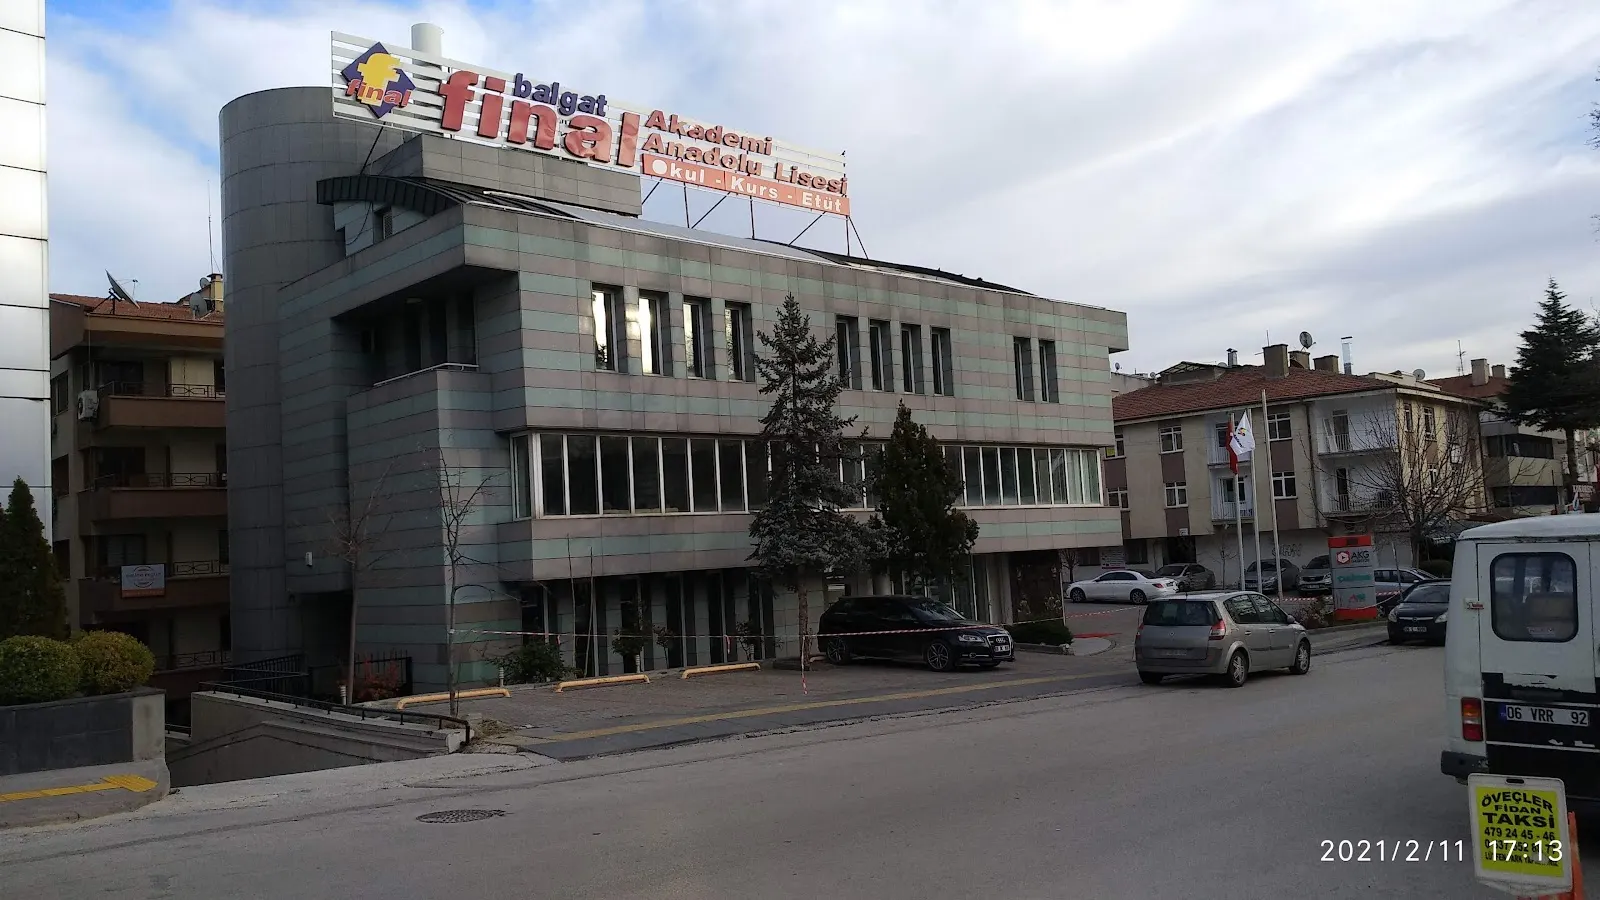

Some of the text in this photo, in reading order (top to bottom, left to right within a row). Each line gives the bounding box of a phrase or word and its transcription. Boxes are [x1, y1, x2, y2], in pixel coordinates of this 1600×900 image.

[345, 78, 412, 107] final
[514, 72, 607, 117] balgat
[438, 70, 640, 167] final
[645, 109, 773, 156] Akademi
[642, 132, 848, 195] Anadolu Lisesi
[652, 159, 704, 183] Okul
[730, 175, 778, 199] Kurs
[802, 192, 842, 213] Etüt
[1351, 550, 1370, 560] AKG
[1507, 706, 1587, 725] 06 VRR 92
[1481, 791, 1554, 814] ÖVEÇLER
[1494, 803, 1541, 815] FİDAN
[1482, 812, 1555, 829] TAKSİ
[1484, 826, 1503, 838] 479
[1505, 828, 1518, 839] 24
[1521, 829, 1534, 840] 45
[1543, 831, 1555, 842] 46
